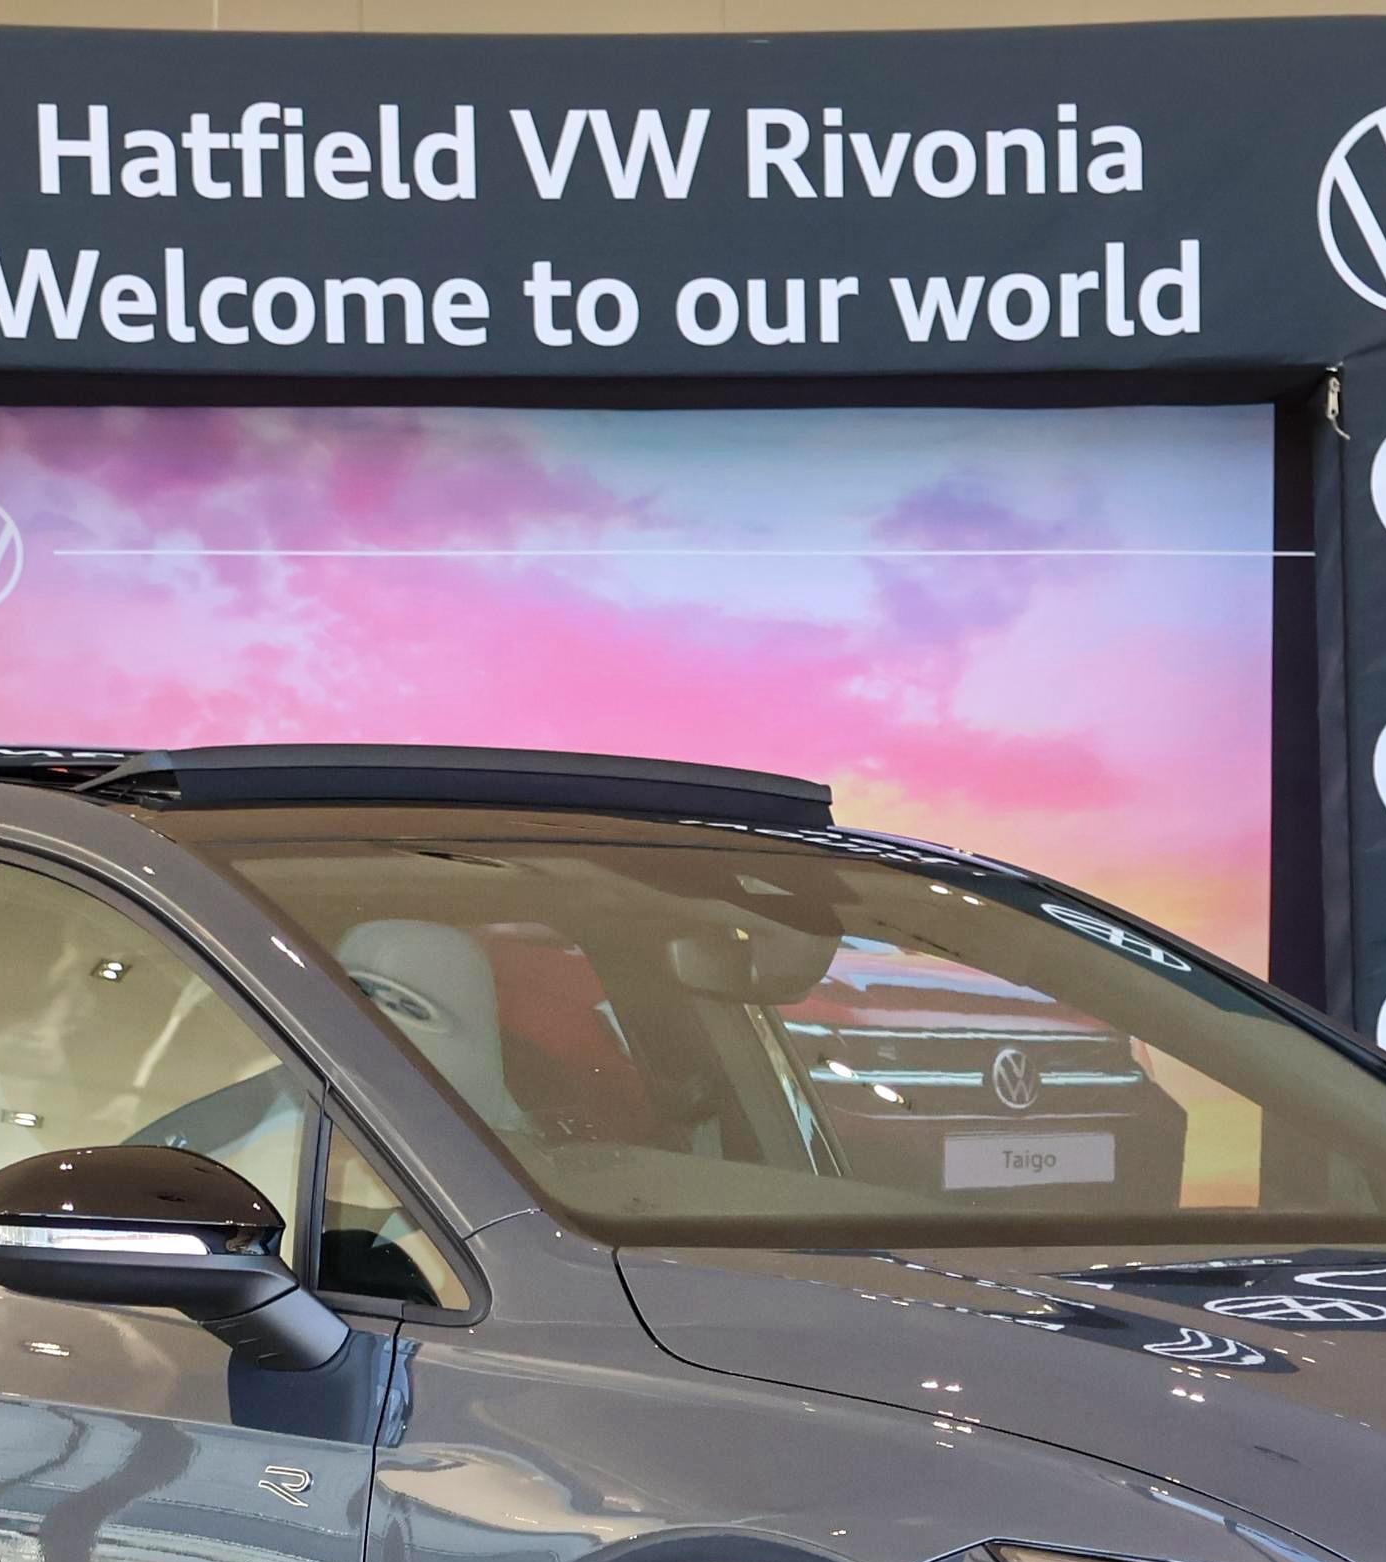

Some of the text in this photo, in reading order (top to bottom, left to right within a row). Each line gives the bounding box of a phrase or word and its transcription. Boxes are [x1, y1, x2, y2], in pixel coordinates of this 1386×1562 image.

[37, 102, 1144, 201] Hatfield VW Rivonia
[523, 260, 640, 347] to
[676, 276, 859, 346] our
[889, 239, 1200, 342] world
[1002, 1150, 1057, 1173] Taigo
